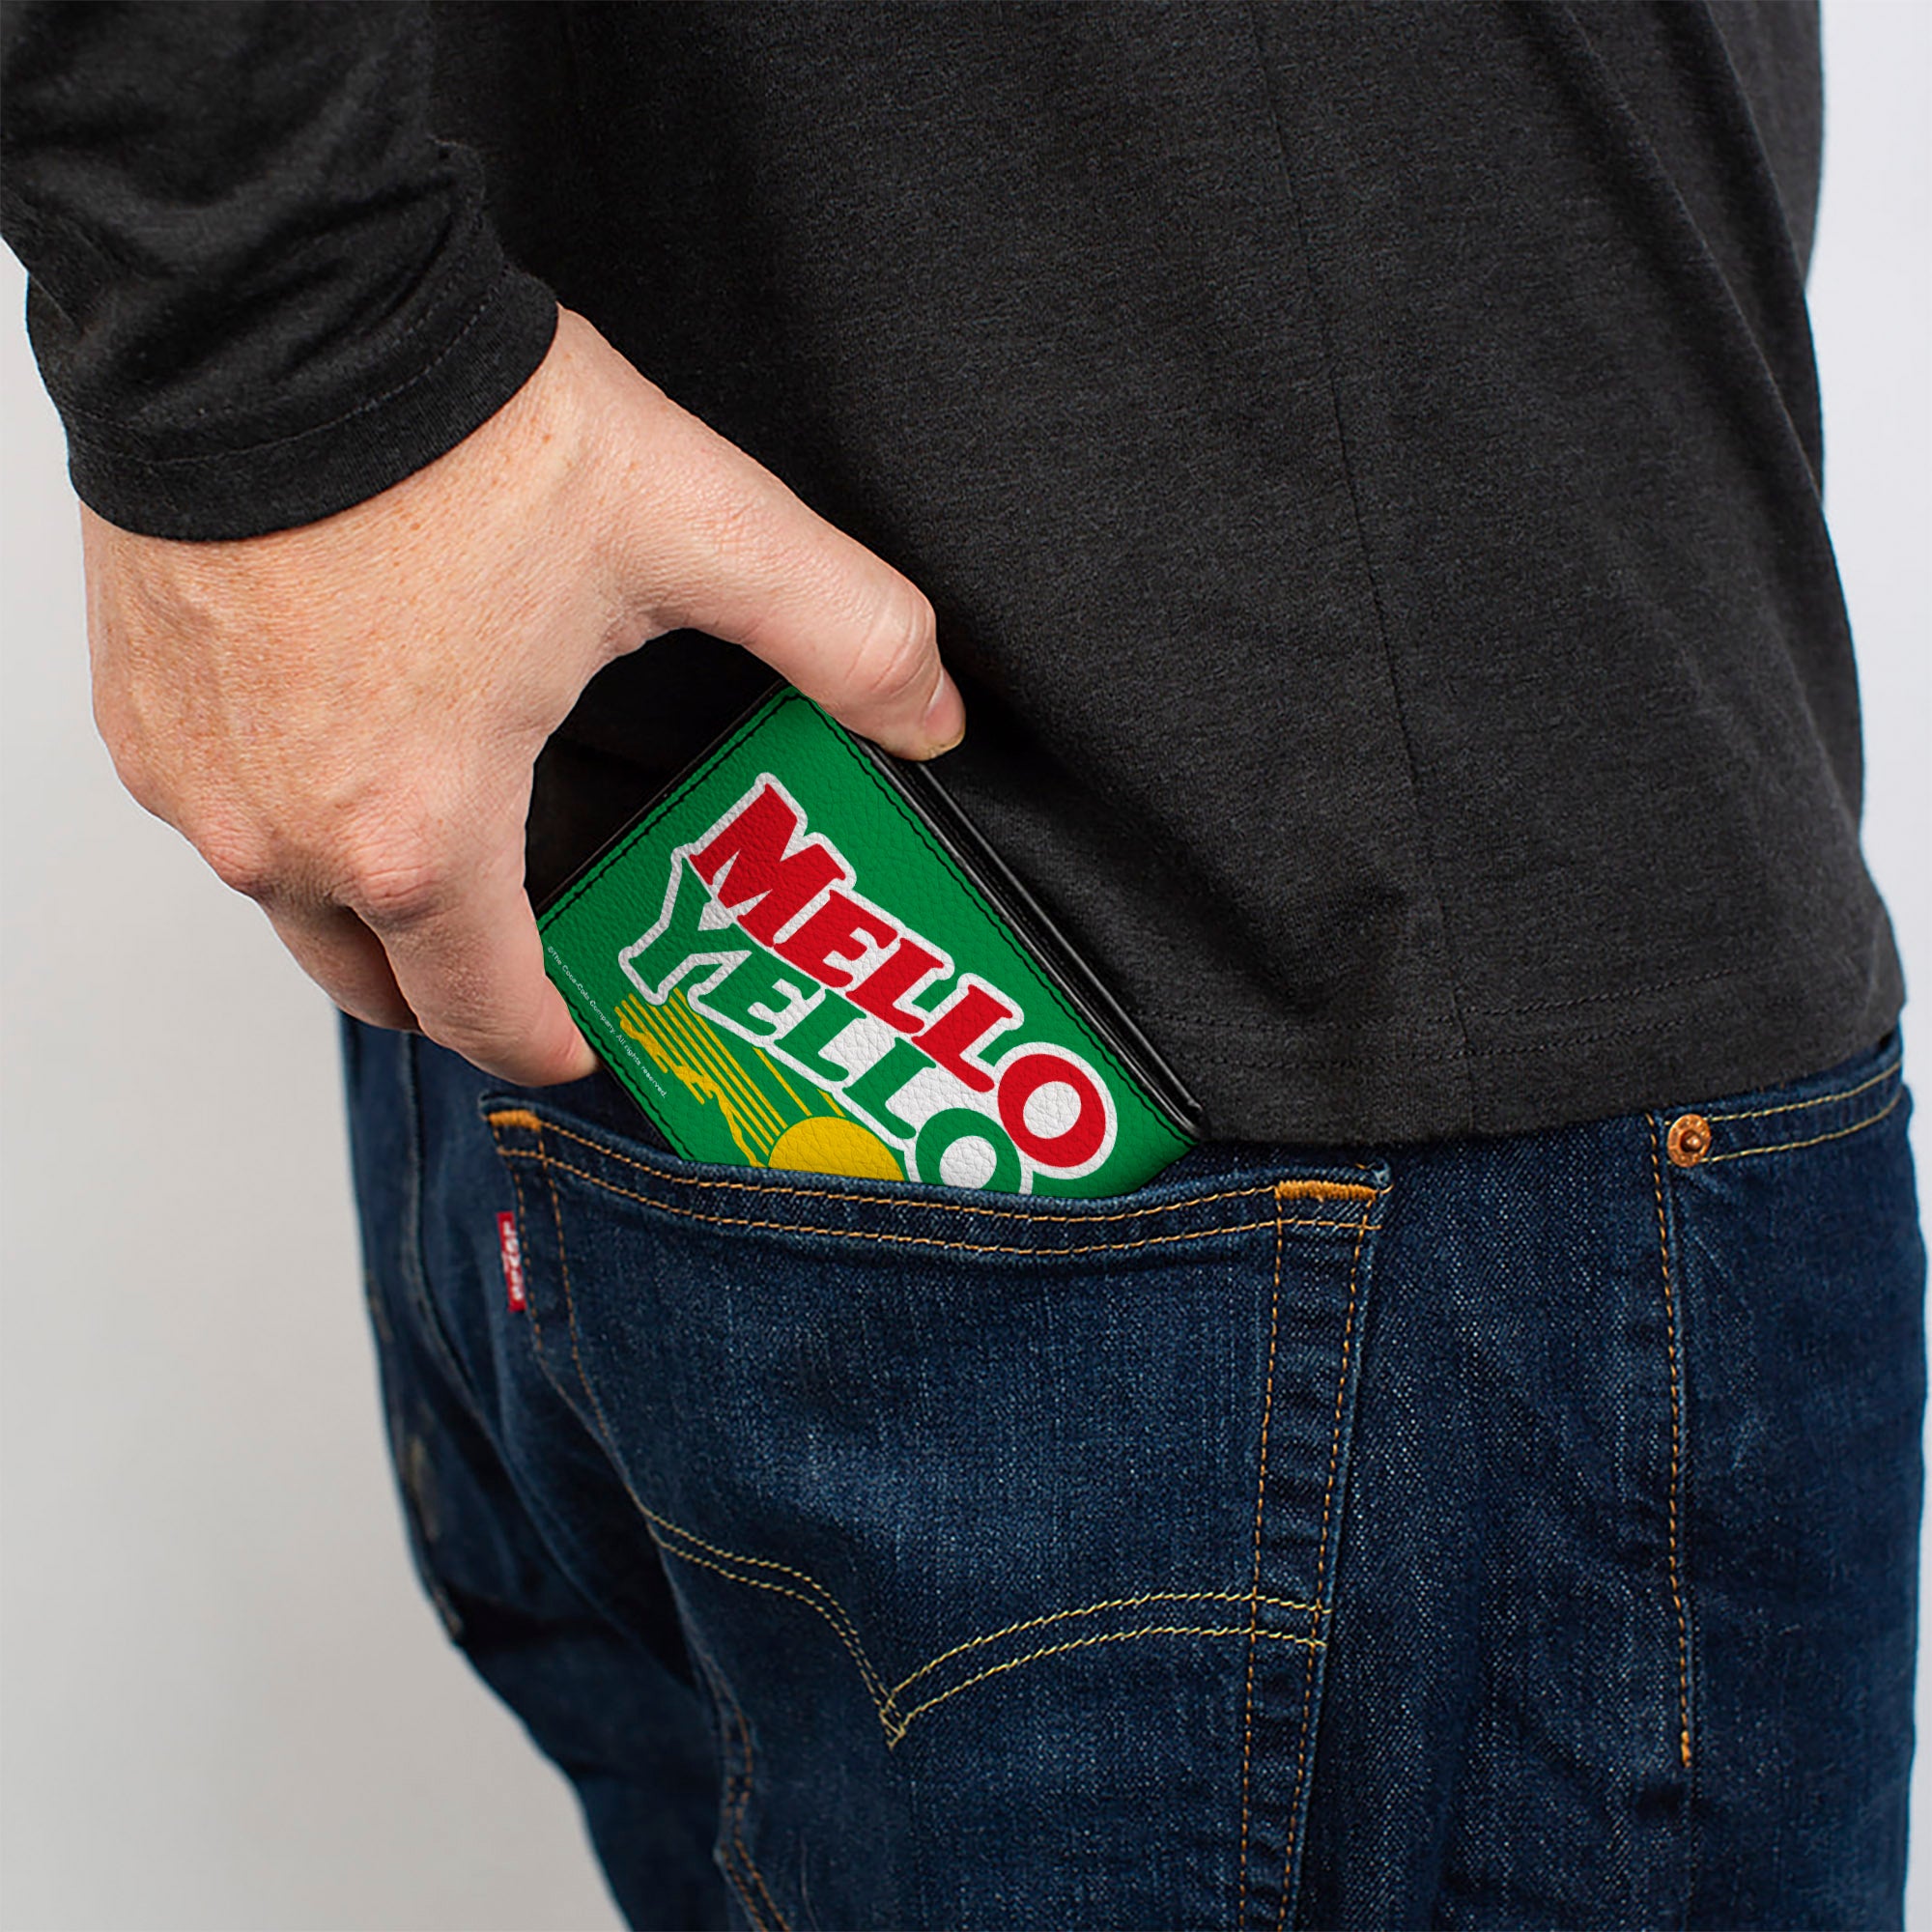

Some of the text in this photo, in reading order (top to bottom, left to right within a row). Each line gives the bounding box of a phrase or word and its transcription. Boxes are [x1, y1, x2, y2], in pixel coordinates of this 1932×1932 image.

[562, 964, 590, 1001] Coca-Cola
[589, 1000, 615, 1034] Company.
[615, 1034, 627, 1045] All
[624, 1044, 641, 1066] rights
[640, 1065, 668, 1098] reserved.
[622, 850, 1024, 1193] YELLO
[687, 781, 1108, 1170] MELLO
